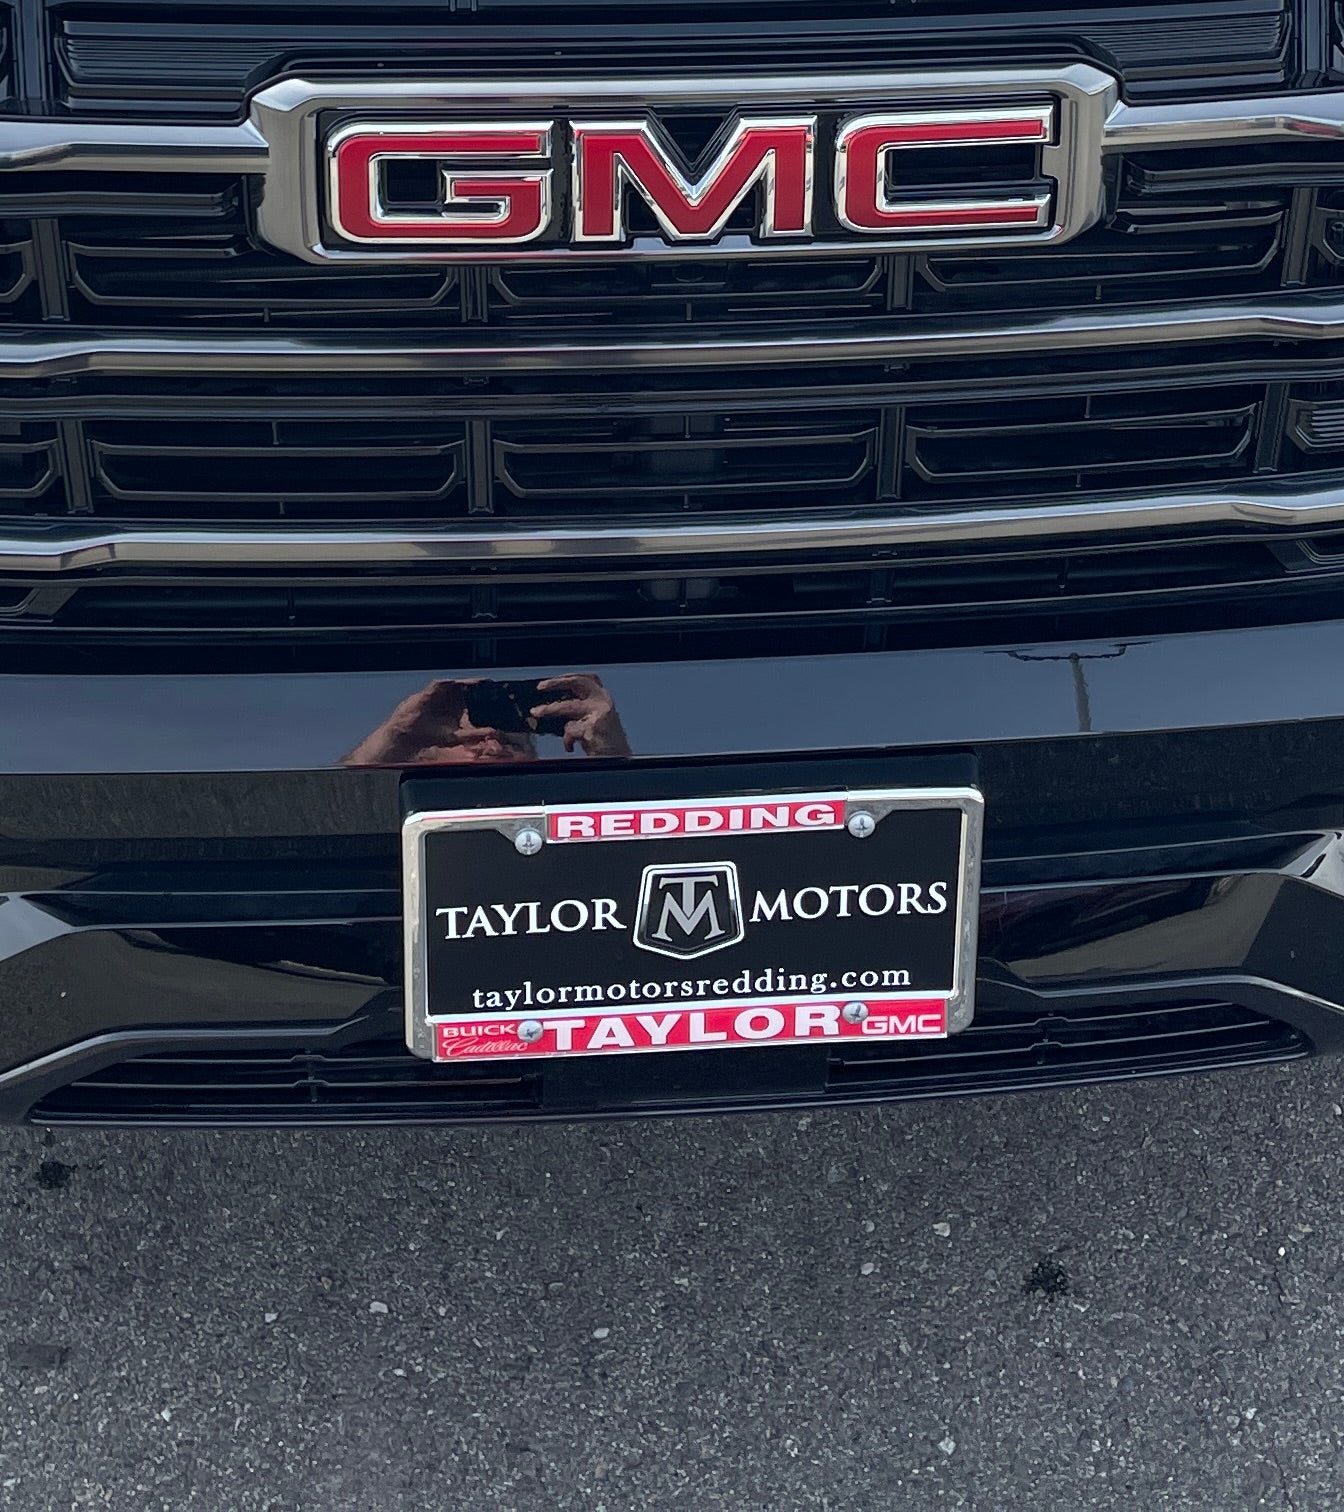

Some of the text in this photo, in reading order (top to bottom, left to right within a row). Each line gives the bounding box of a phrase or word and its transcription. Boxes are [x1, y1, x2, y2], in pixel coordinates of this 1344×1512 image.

[324, 102, 1054, 245] GMC
[557, 803, 836, 838] REDDING
[435, 898, 627, 940] TAYLOR
[748, 881, 948, 923] MOTORS
[472, 967, 912, 1011] taylormotorsredding.com
[442, 1023, 518, 1038] BUICK
[542, 1004, 842, 1052] TAYLOR
[861, 1013, 942, 1035] GMC
[442, 1036, 530, 1057] Cadillac
